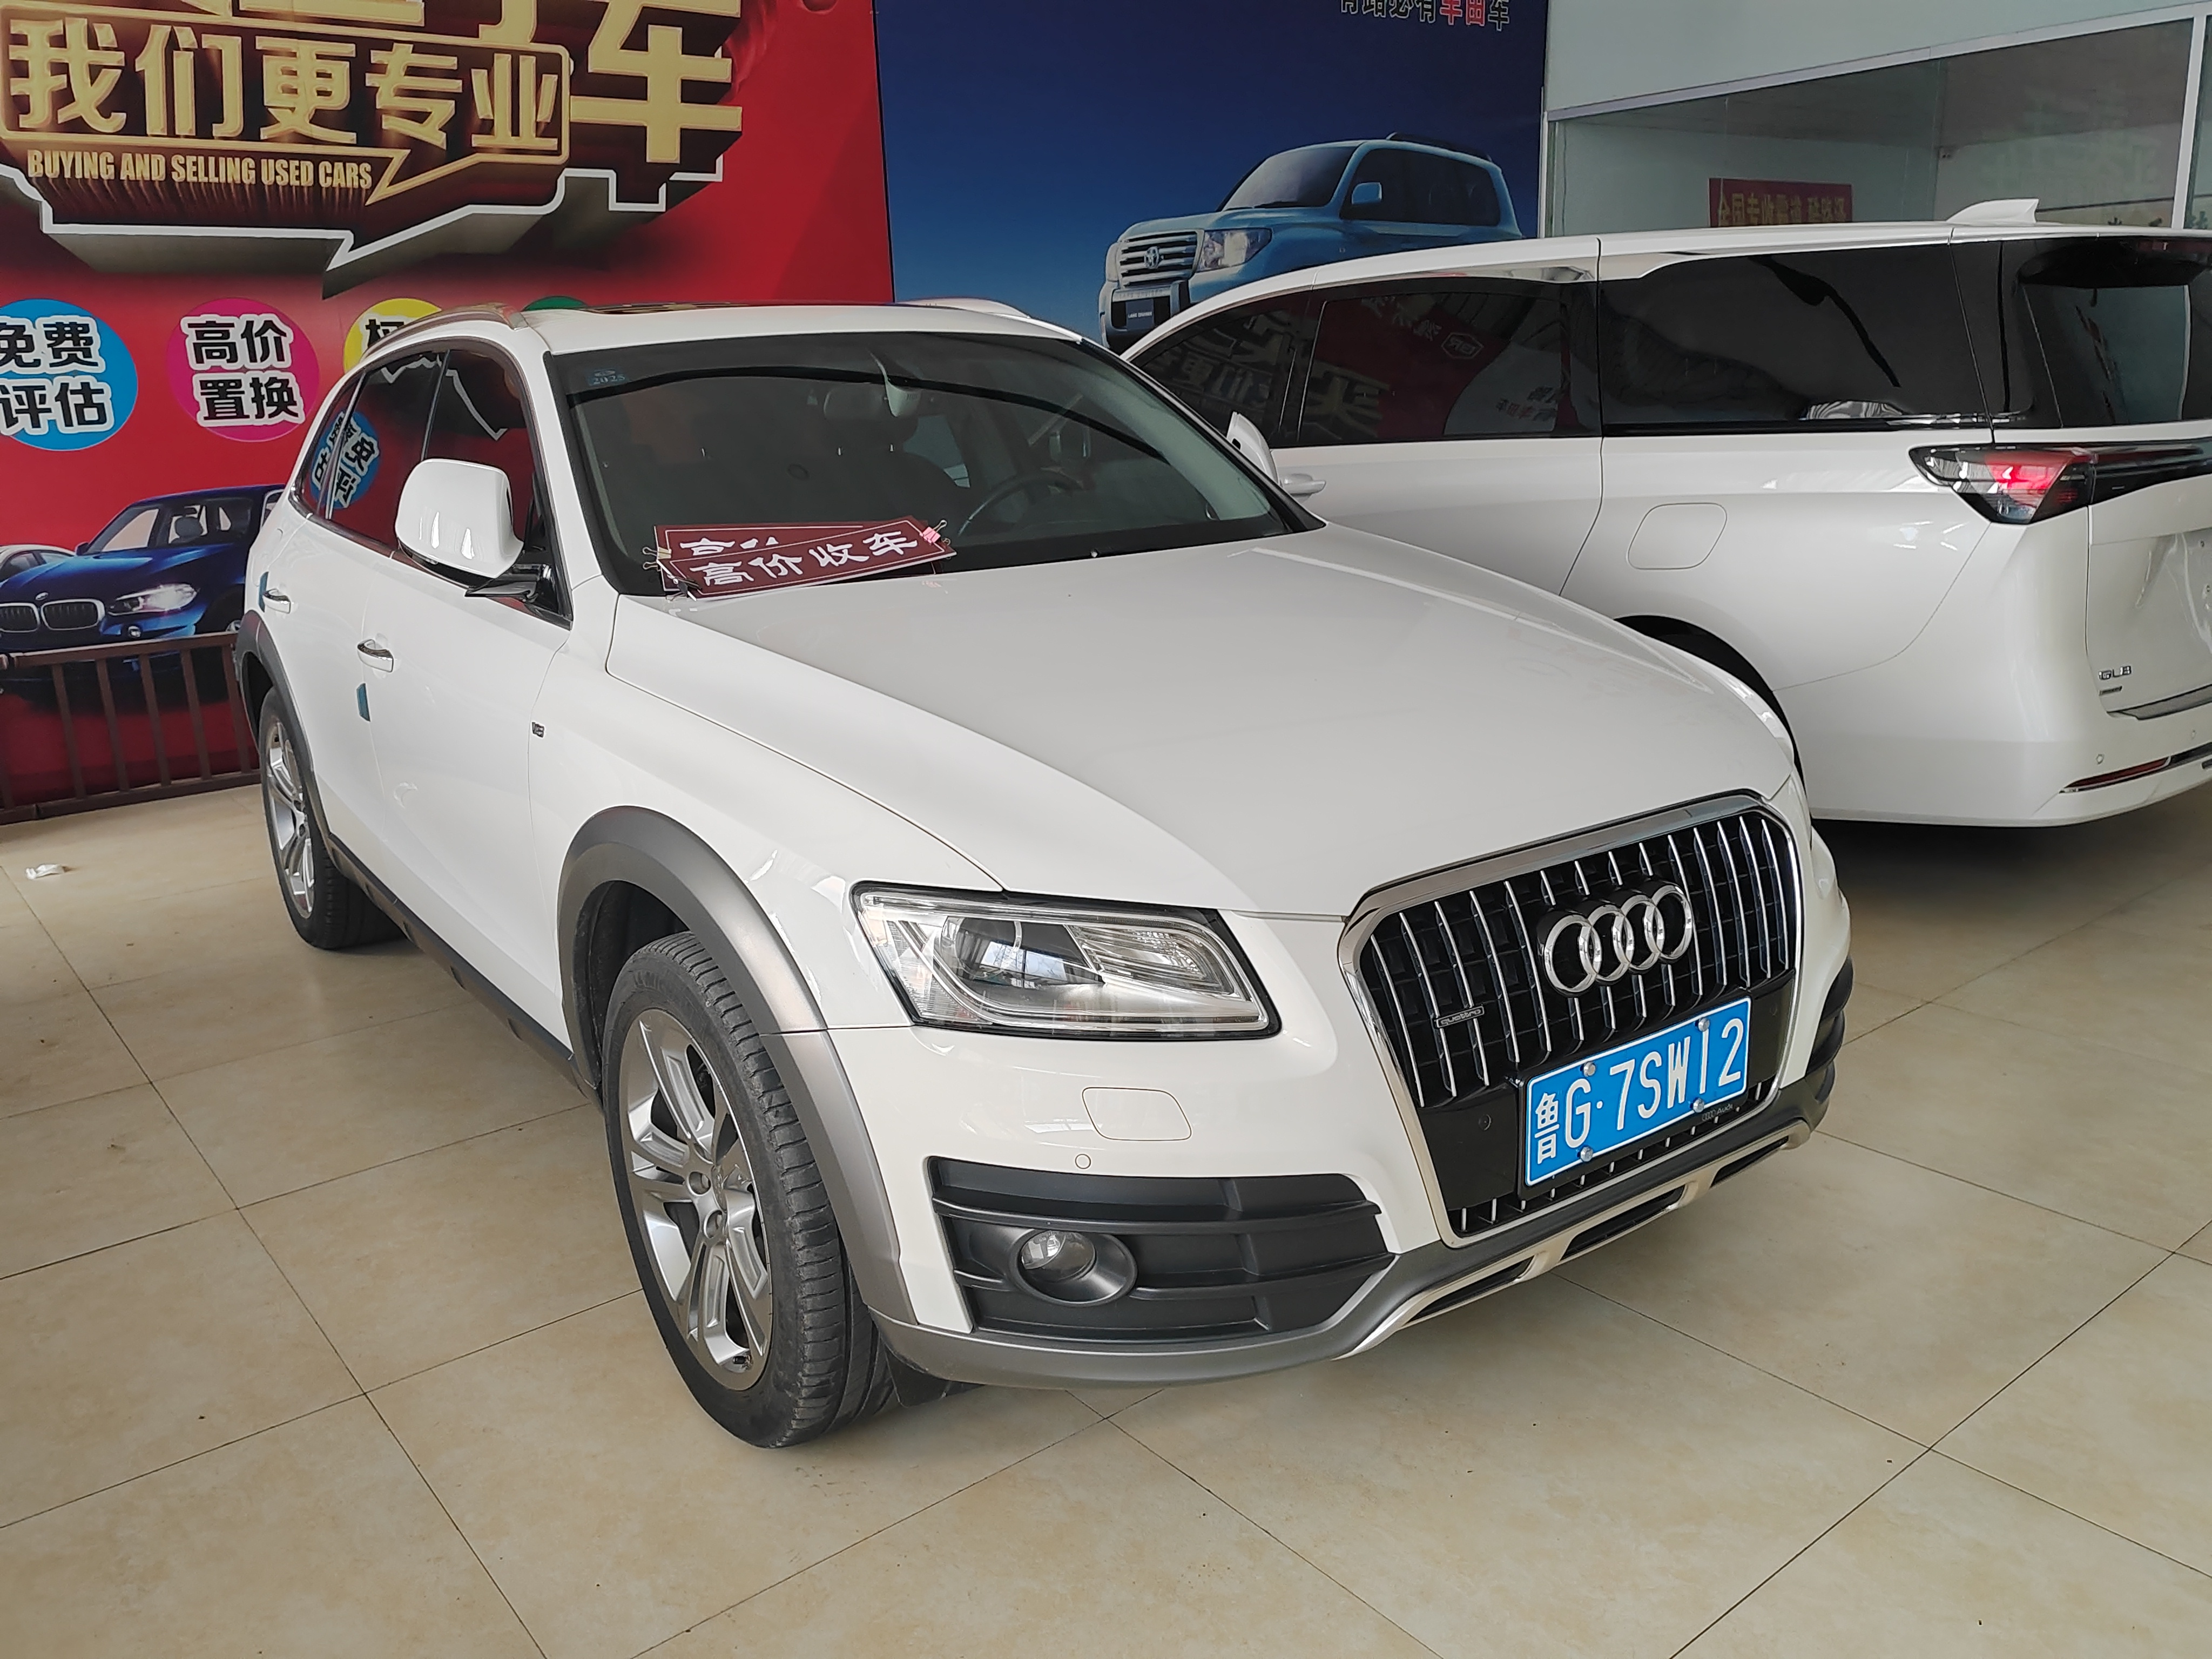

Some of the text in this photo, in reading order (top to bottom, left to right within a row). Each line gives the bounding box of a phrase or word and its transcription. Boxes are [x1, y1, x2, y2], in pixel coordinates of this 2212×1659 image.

[8, 18, 558, 151] 我们更专业
[28, 150, 373, 188] BUYING AND SELLING USED CARS
[0, 320, 100, 369] 免费
[186, 318, 288, 365] 高价
[0, 381, 107, 430] 评估
[199, 377, 299, 421] 置换
[690, 530, 918, 586] 高价收车
[1440, 1008, 1481, 1025] quattro
[1716, 1103, 1734, 1115] Audi
